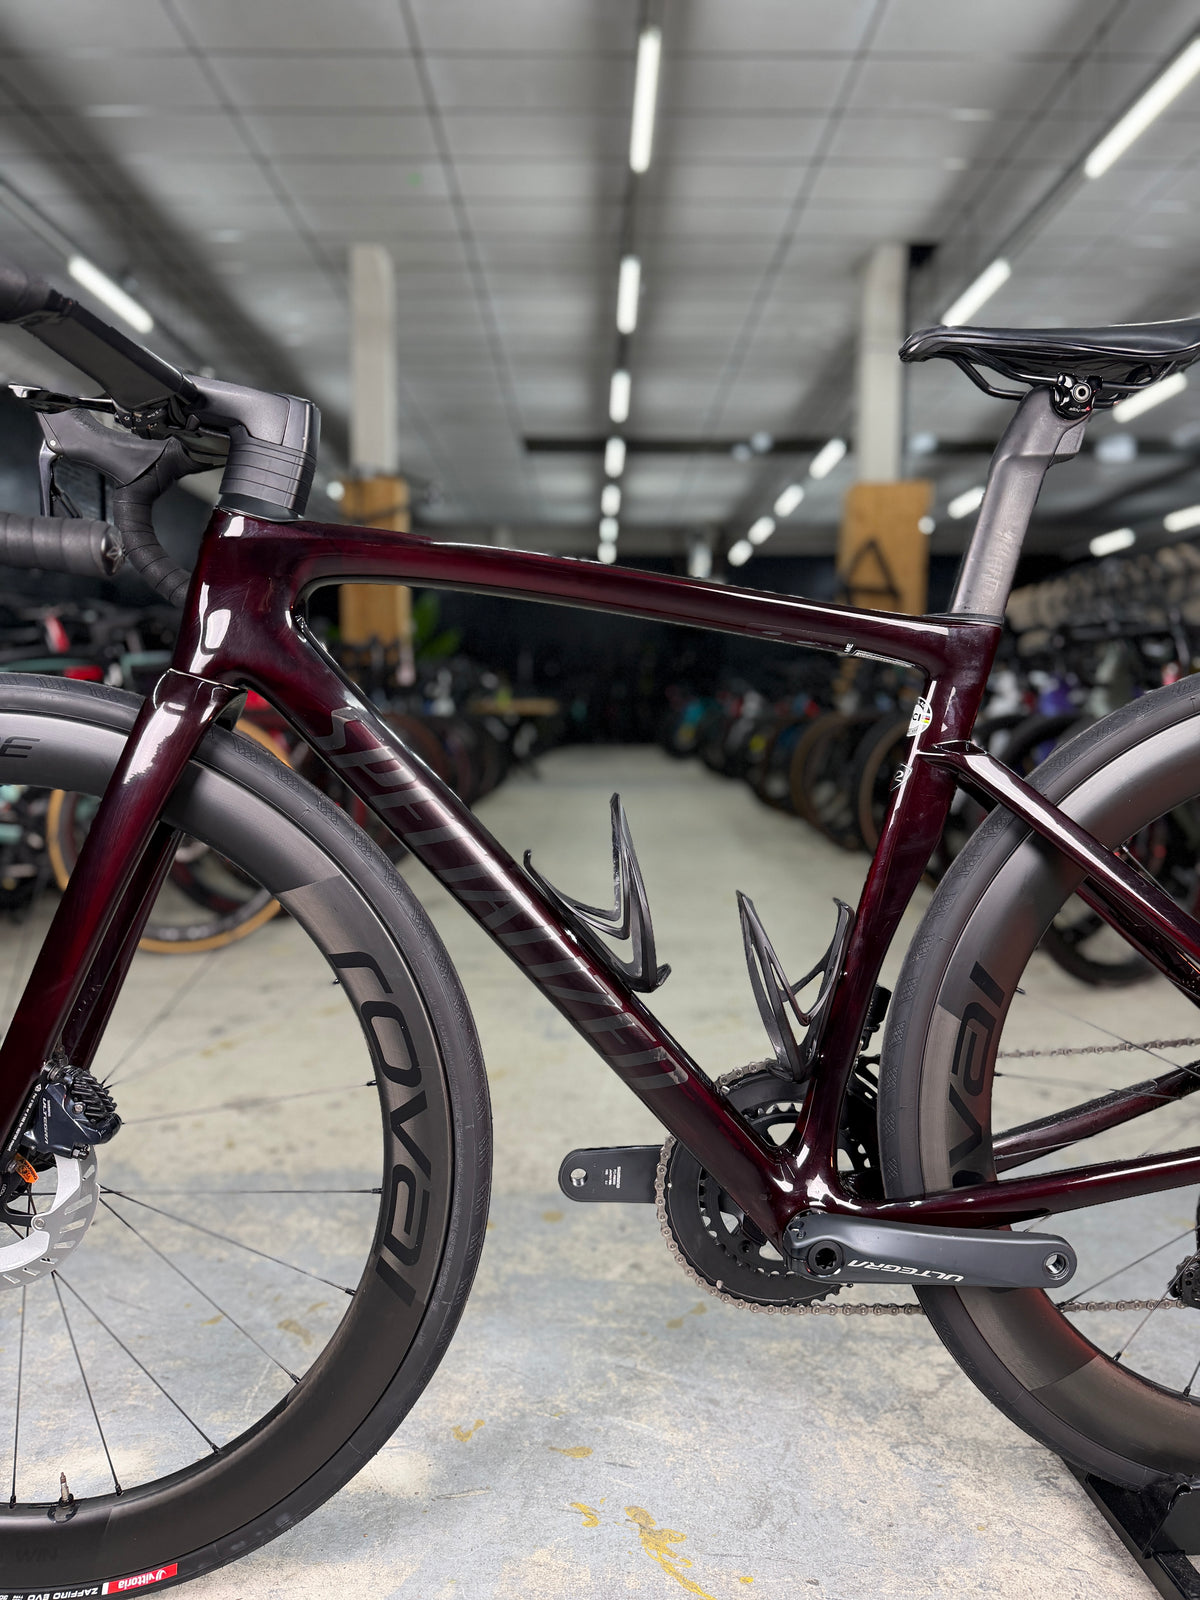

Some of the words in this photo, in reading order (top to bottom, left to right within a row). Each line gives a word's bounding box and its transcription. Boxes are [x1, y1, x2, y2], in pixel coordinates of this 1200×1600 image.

[848, 1258, 965, 1283] ULTEGRA
[118, 1573, 155, 1590] vittoria
[52, 1586, 99, 1600] ZAFFIRO
